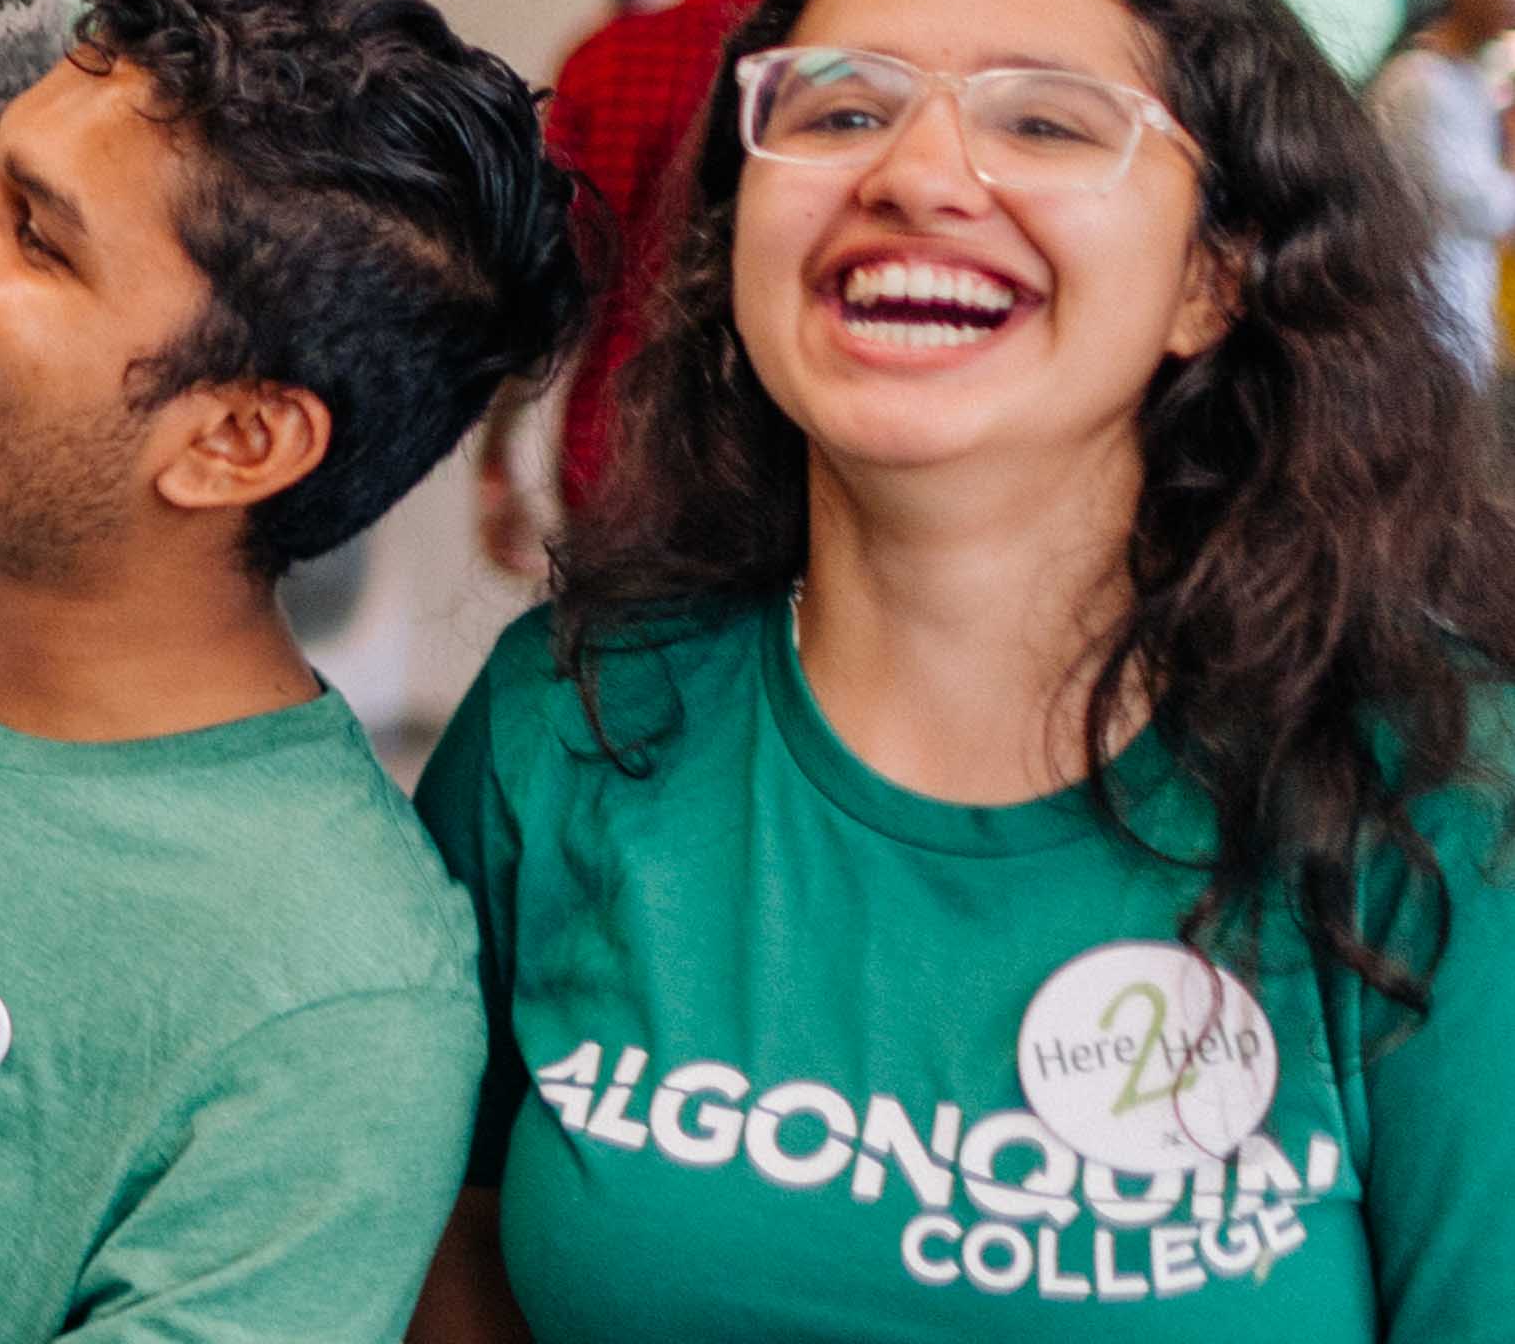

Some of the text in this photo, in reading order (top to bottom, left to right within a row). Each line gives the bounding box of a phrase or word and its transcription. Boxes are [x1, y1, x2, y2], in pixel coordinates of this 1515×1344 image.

[1034, 980, 1261, 1117] Here 2 Help
[536, 1039, 1340, 1227] ALGONQUIN
[901, 1197, 1308, 1302] COLLEGE
